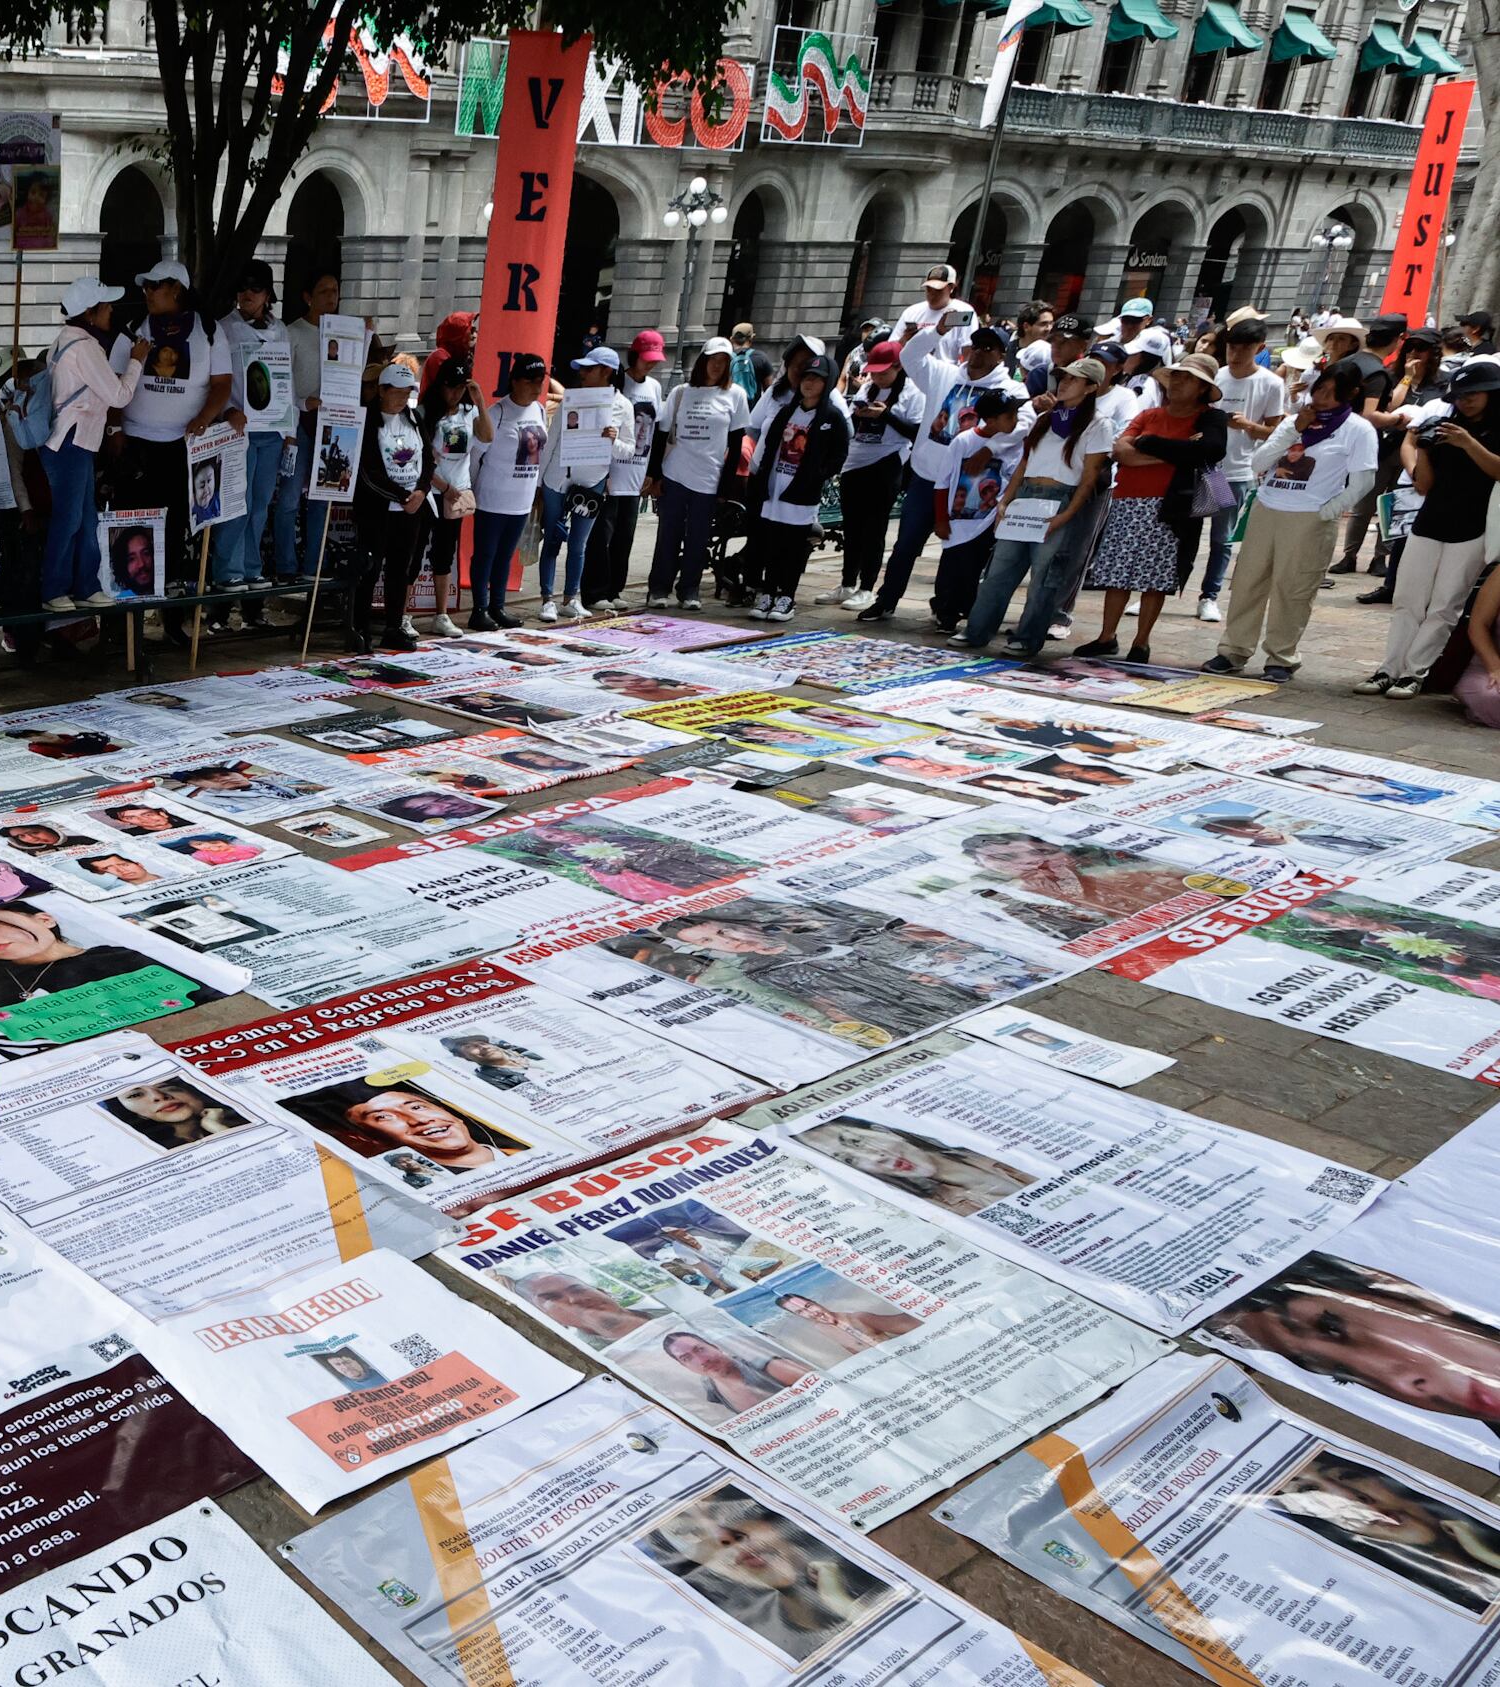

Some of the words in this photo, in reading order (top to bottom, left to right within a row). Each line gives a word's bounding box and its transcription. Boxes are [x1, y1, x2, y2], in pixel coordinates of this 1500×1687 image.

[396, 832, 468, 855] SE
[468, 796, 620, 840] BUSCA
[406, 864, 505, 895] AGUSTINA
[1166, 915, 1238, 949] SE
[1230, 868, 1353, 926] BUSCA
[174, 1019, 294, 1059] Creemos
[315, 978, 449, 1021] Confiamos
[253, 1037, 287, 1055] en
[325, 999, 427, 1032] Regreso
[456, 1206, 532, 1248] SE
[461, 1226, 564, 1272] DANIEL
[565, 1194, 642, 1239] PÉREZ
[637, 1138, 780, 1205] DOMÍNGUEZ
[201, 1279, 381, 1349] DESAPARECIDO
[8, 1364, 58, 1390] Pensar
[333, 1392, 358, 1413] JOSÉ
[359, 1384, 401, 1403] SANTOS
[400, 1371, 433, 1389] CRUZ
[4, 1384, 112, 1441] encontremos,
[367, 1429, 417, 1455] SABUESOS
[10, 1549, 27, 1566] a
[27, 1529, 82, 1559] casa.
[474, 1535, 533, 1570] BOLETÍN
[531, 1520, 554, 1541] DE
[553, 1479, 620, 1526] BÚSQUEDA
[489, 1570, 532, 1598] KARLA
[530, 1535, 592, 1576] ALEJANDRA
[588, 1514, 619, 1538] TELA
[615, 1492, 656, 1521] FLORES
[14, 1571, 227, 1687] GRANADOS
